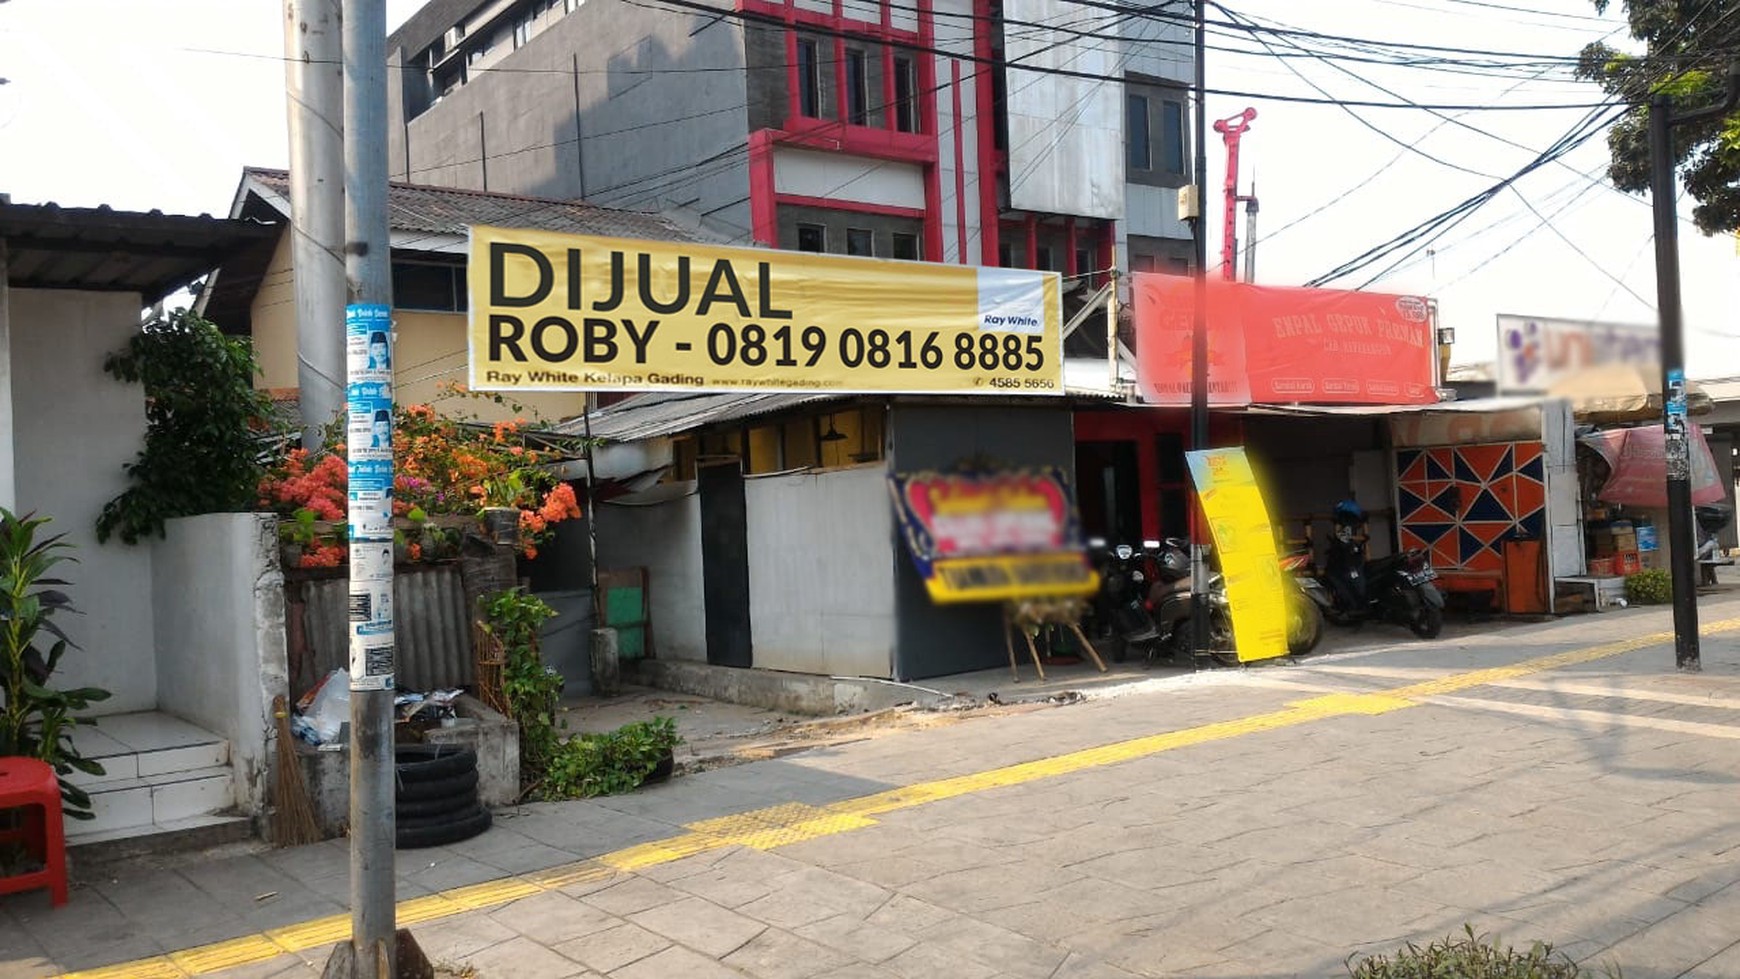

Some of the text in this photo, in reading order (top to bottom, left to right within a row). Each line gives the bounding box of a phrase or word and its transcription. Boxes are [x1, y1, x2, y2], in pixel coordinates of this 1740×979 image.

[489, 242, 793, 319] DIJUAL
[983, 315, 1038, 327] Ray White
[488, 314, 660, 364] ROBY
[707, 323, 826, 367] 0819
[840, 329, 943, 370] 0816
[954, 332, 1044, 371] 8885
[486, 371, 522, 385] Ray
[528, 372, 579, 383] White
[584, 372, 643, 386] Kelapa
[648, 373, 704, 386] Gading
[989, 377, 1021, 388] 4585
